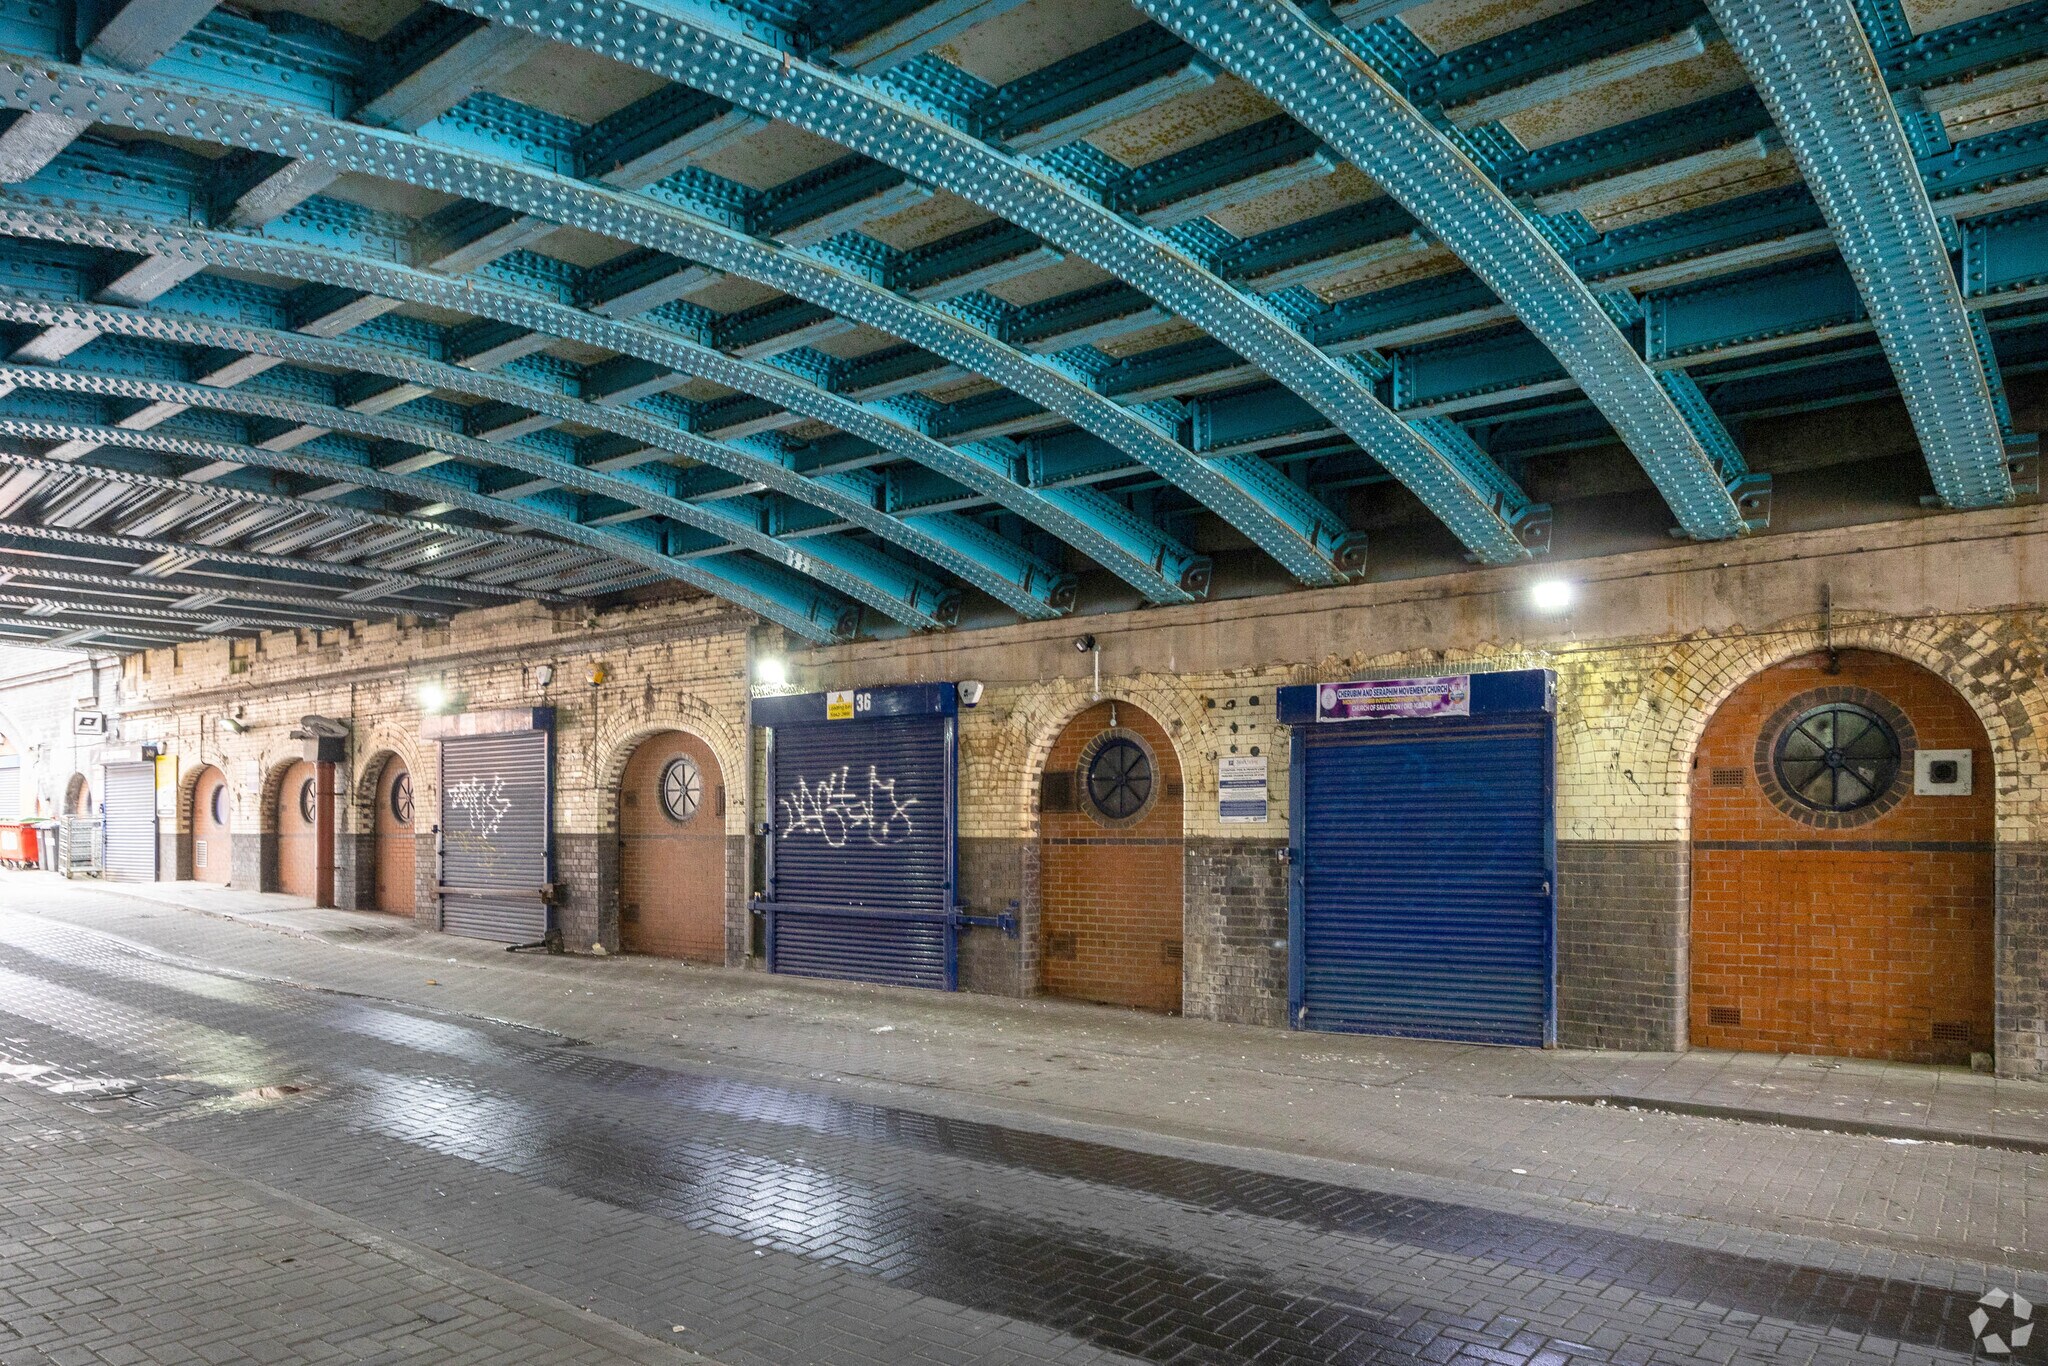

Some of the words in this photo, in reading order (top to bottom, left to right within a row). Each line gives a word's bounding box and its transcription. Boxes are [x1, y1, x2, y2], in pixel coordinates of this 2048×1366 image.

[1338, 689, 1361, 698] CHERUBIM
[1362, 688, 1372, 697] AND
[1373, 687, 1398, 697] SERAPHIM
[1399, 686, 1427, 695] MOVEMENT
[1427, 684, 1448, 694] CHURCH
[856, 693, 872, 712] 36
[1352, 704, 1370, 712] CHURCH
[1376, 703, 1400, 711] SALVATION
